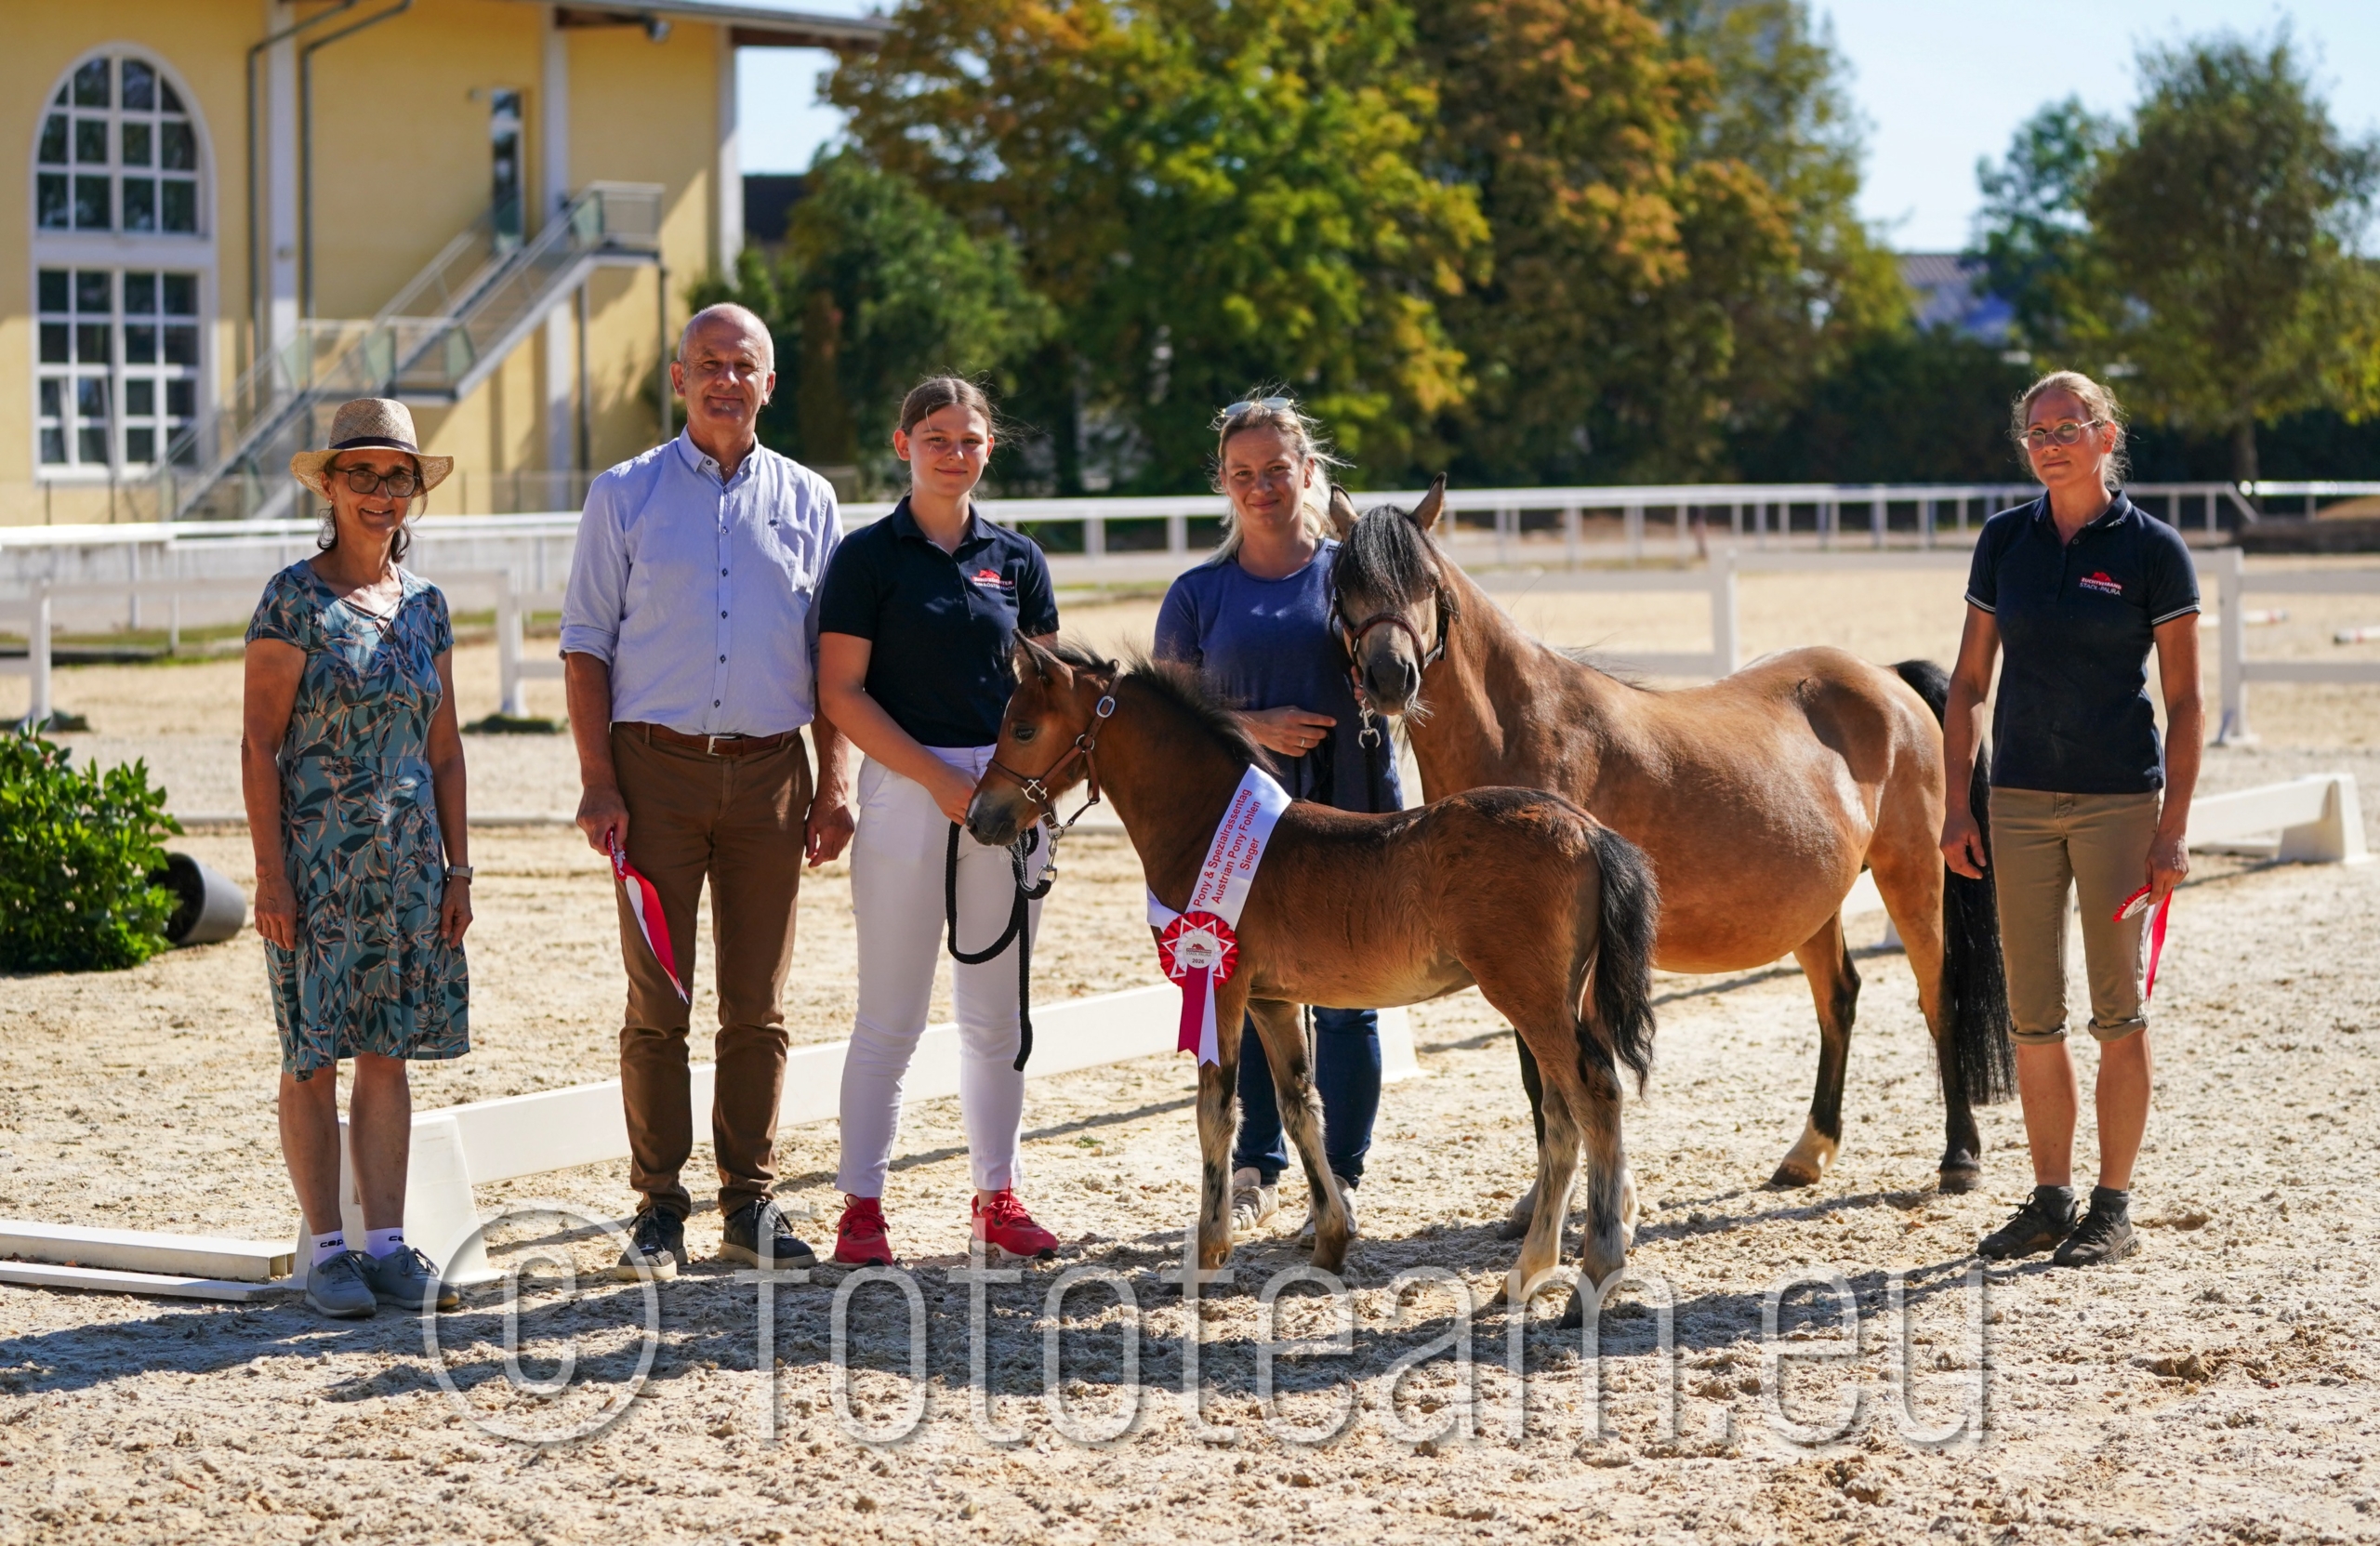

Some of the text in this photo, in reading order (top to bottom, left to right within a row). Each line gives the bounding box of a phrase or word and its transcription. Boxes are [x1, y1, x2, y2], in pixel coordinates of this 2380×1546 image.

[1193, 788, 1252, 907] Pony & Spezialrassentag
[1211, 801, 1262, 904] Austrian Pony Fohlen
[1239, 838, 1260, 870] Sieger
